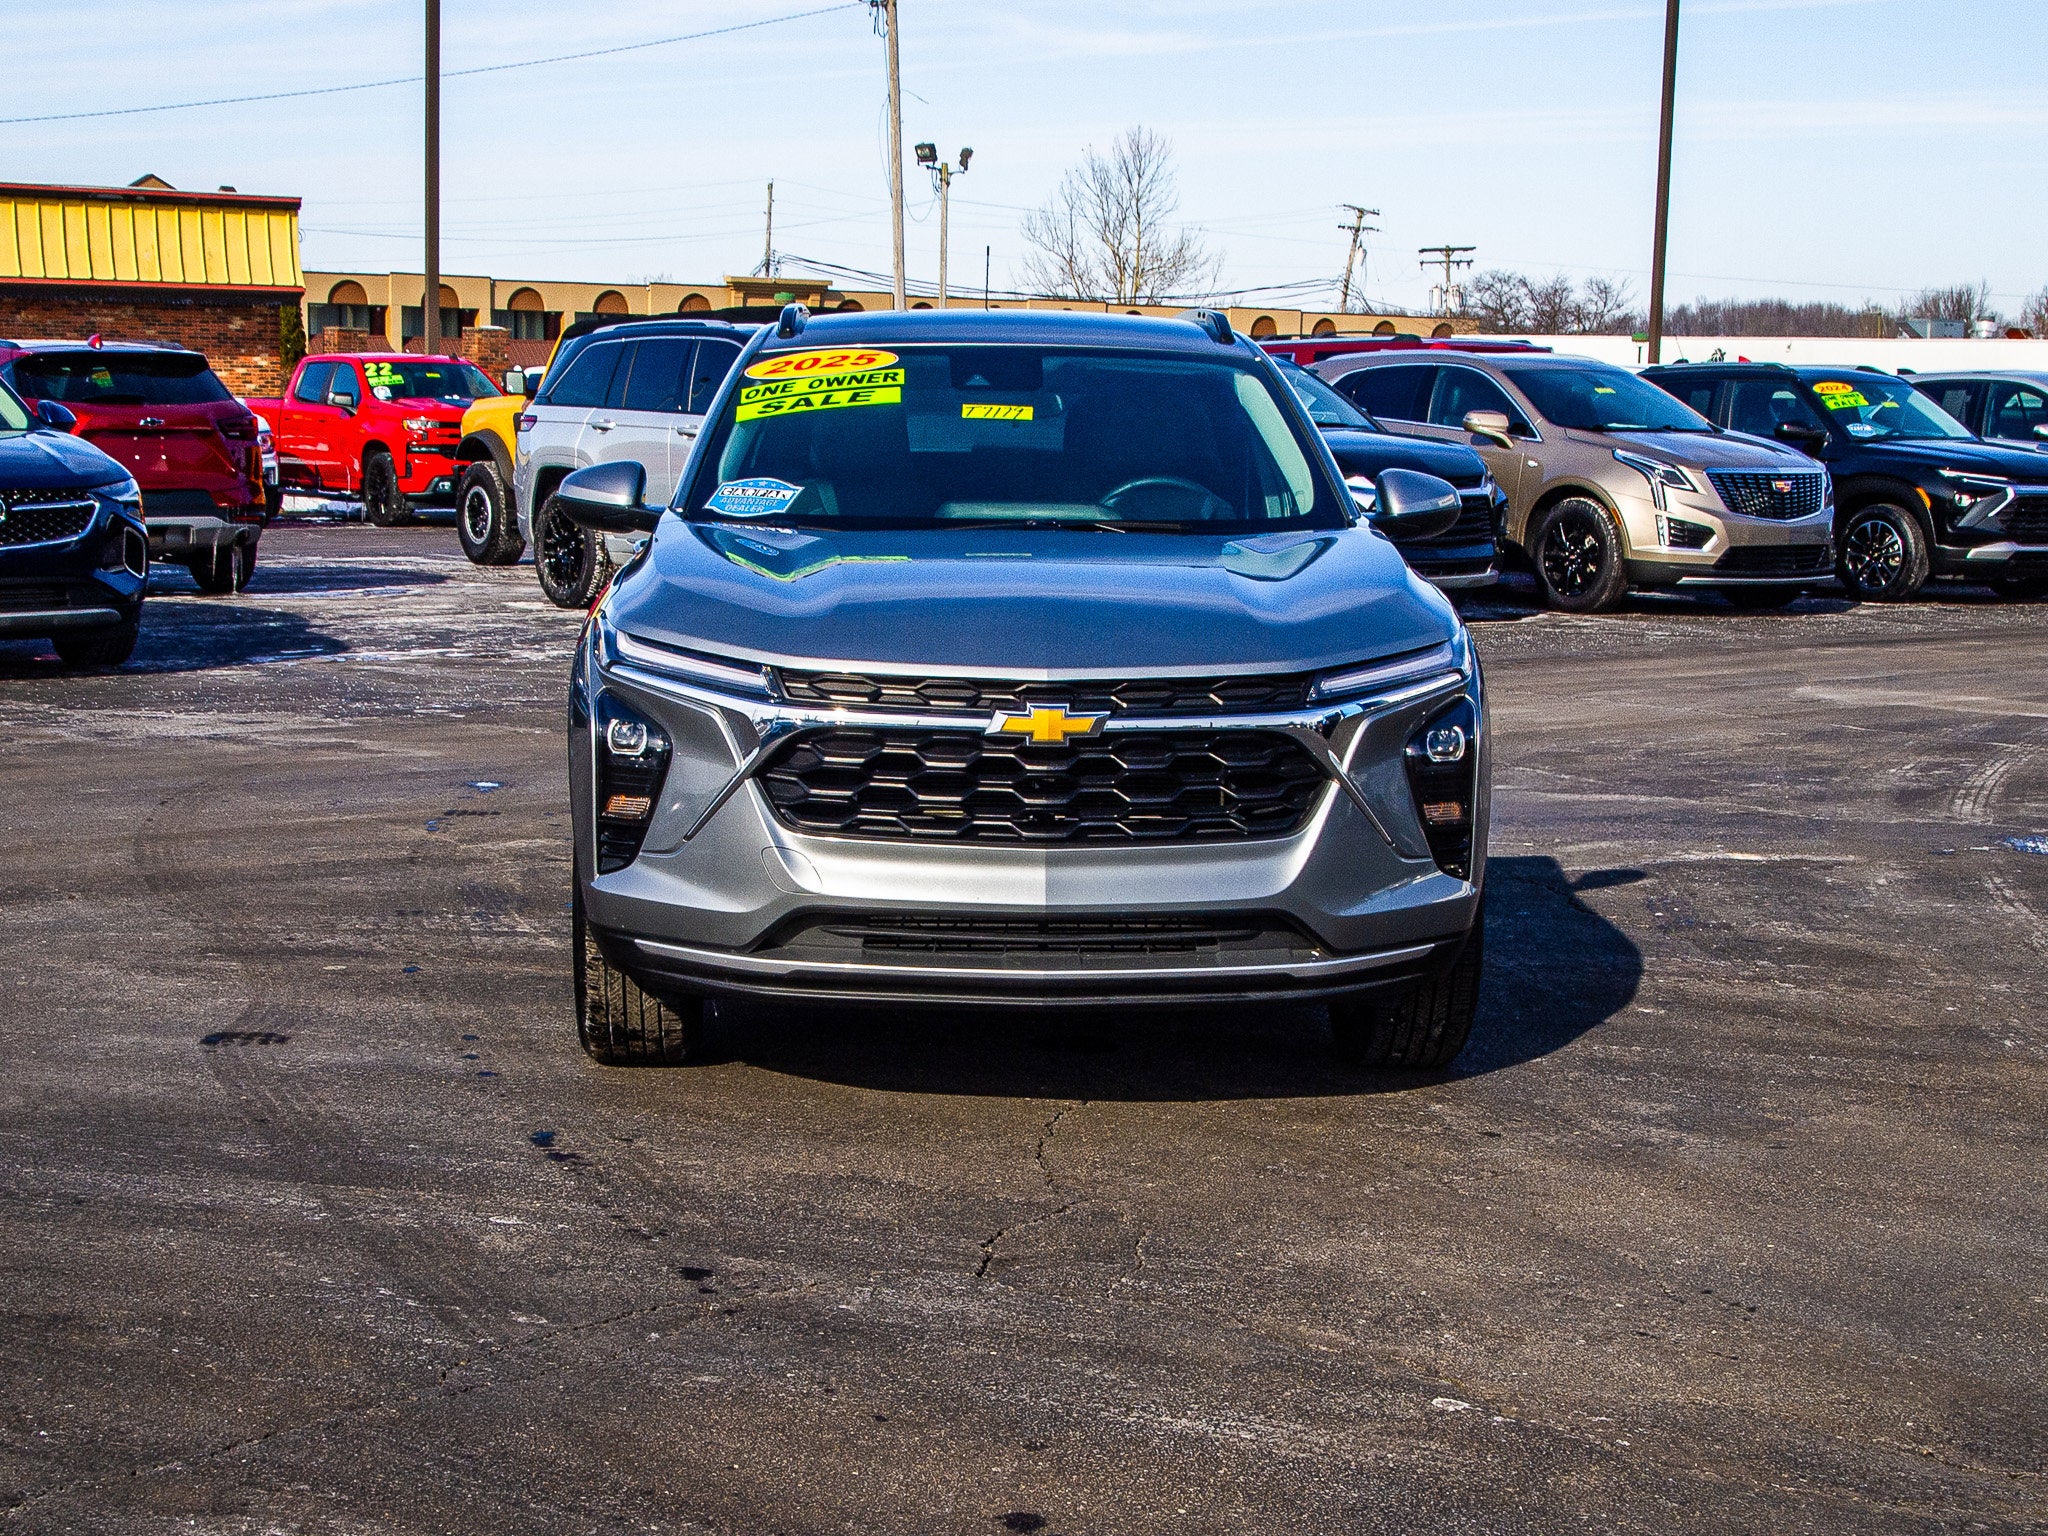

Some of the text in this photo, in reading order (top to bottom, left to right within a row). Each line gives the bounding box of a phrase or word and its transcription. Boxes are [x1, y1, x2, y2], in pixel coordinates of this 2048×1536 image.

[364, 362, 393, 377] 22
[764, 353, 881, 375] 2025
[745, 372, 900, 400] ONE OWNER
[757, 390, 876, 414] SALE
[724, 504, 765, 513] DEALER
